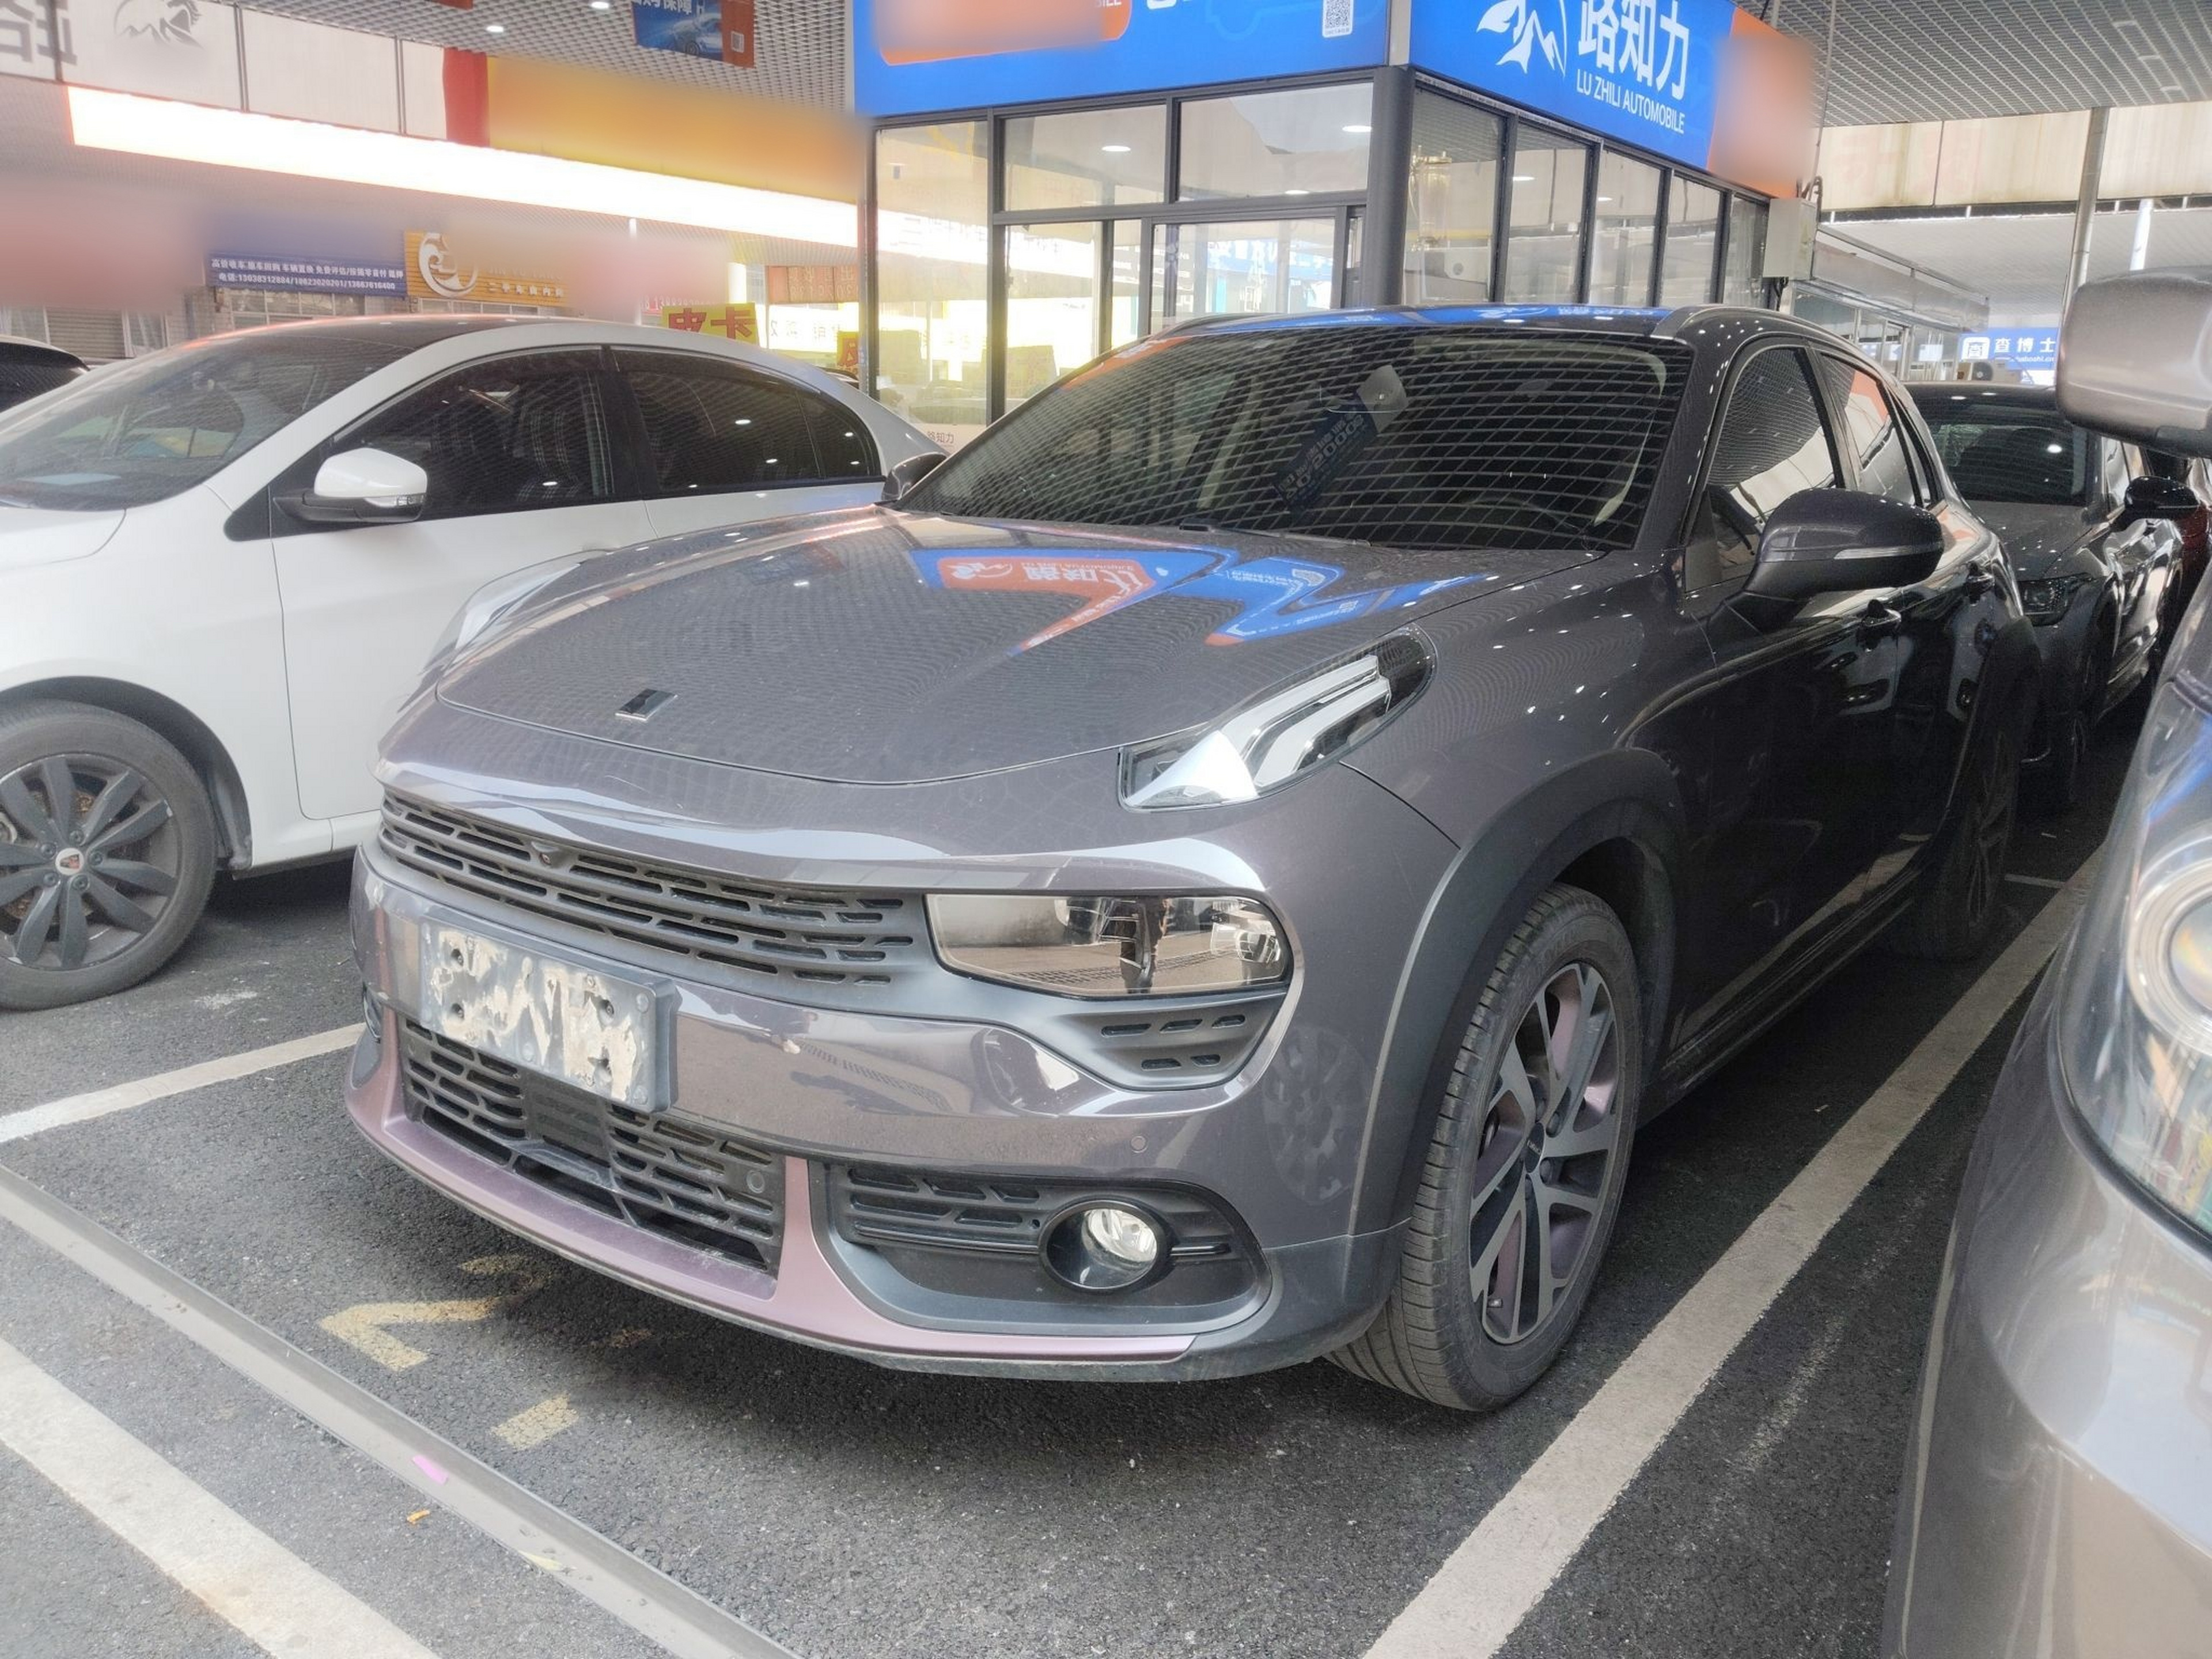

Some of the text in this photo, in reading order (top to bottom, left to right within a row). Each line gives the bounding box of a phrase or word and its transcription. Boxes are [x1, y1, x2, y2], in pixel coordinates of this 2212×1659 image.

[1578, 0, 1689, 100] 路知力
[1577, 69, 1592, 96] LU
[1593, 75, 1621, 108] ZHILI
[1622, 89, 1685, 134] AUTOMOBILE
[1994, 337, 2056, 353] 查博士
